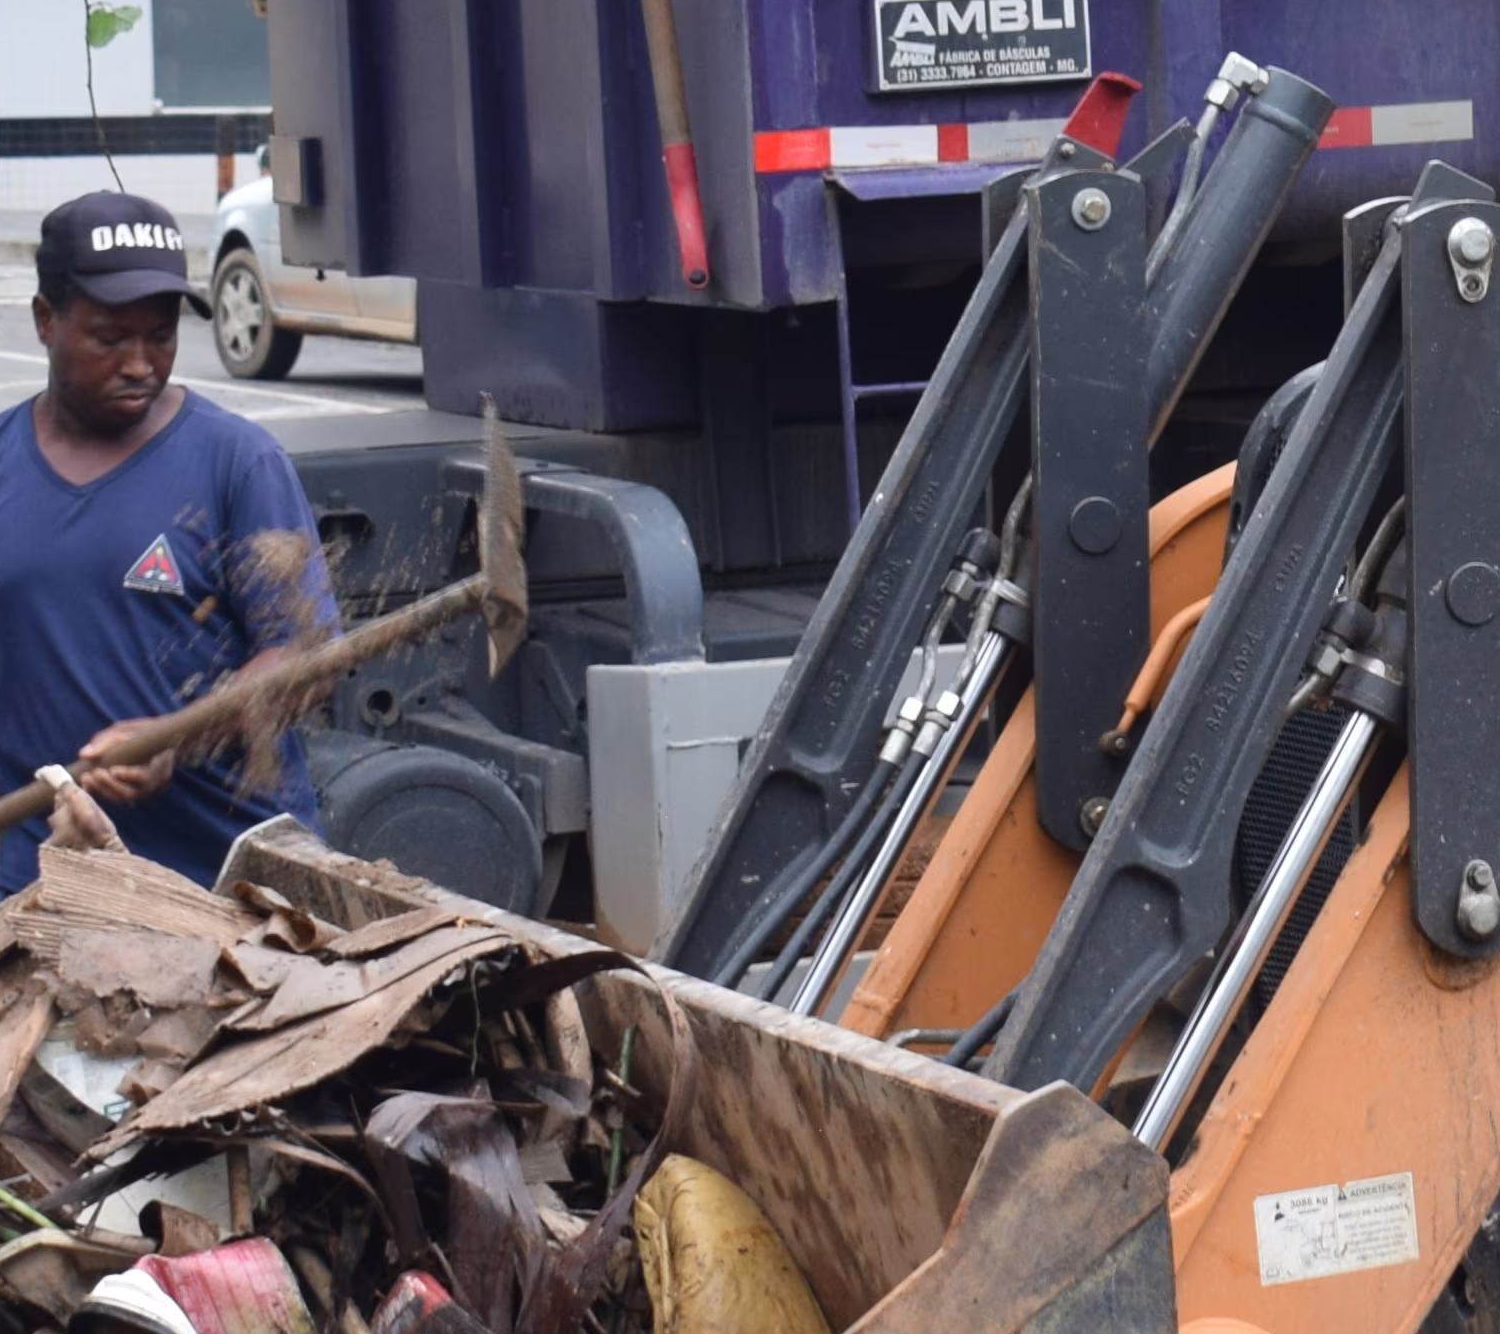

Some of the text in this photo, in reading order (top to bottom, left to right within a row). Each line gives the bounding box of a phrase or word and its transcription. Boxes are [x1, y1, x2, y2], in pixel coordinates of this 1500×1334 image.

[939, 49, 981, 65] FÁBRICA
[983, 48, 996, 62] DE
[999, 46, 1051, 61] BÁSCULAS
[897, 67, 918, 83] (31)
[987, 60, 1047, 76] CONTAGEM
[1349, 1181, 1407, 1198] ADVERTÊNCIA
